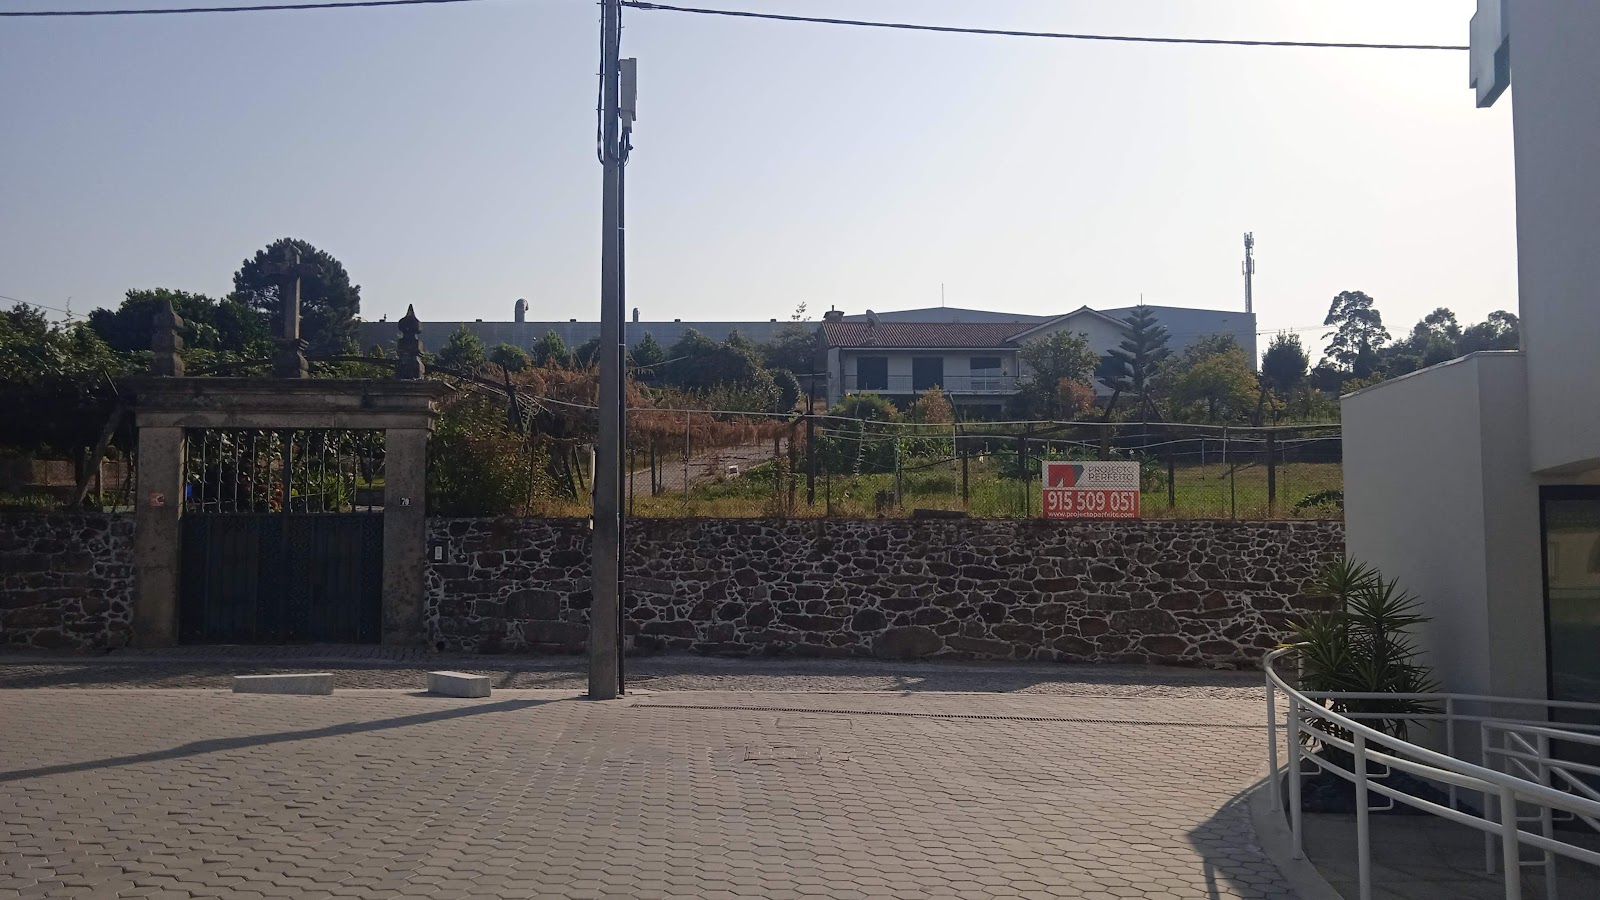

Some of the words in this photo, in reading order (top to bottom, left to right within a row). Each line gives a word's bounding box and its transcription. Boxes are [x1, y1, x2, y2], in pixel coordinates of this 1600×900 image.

[1047, 491, 1072, 510] 915
[1076, 491, 1106, 511] 509
[1110, 491, 1135, 511] 051
